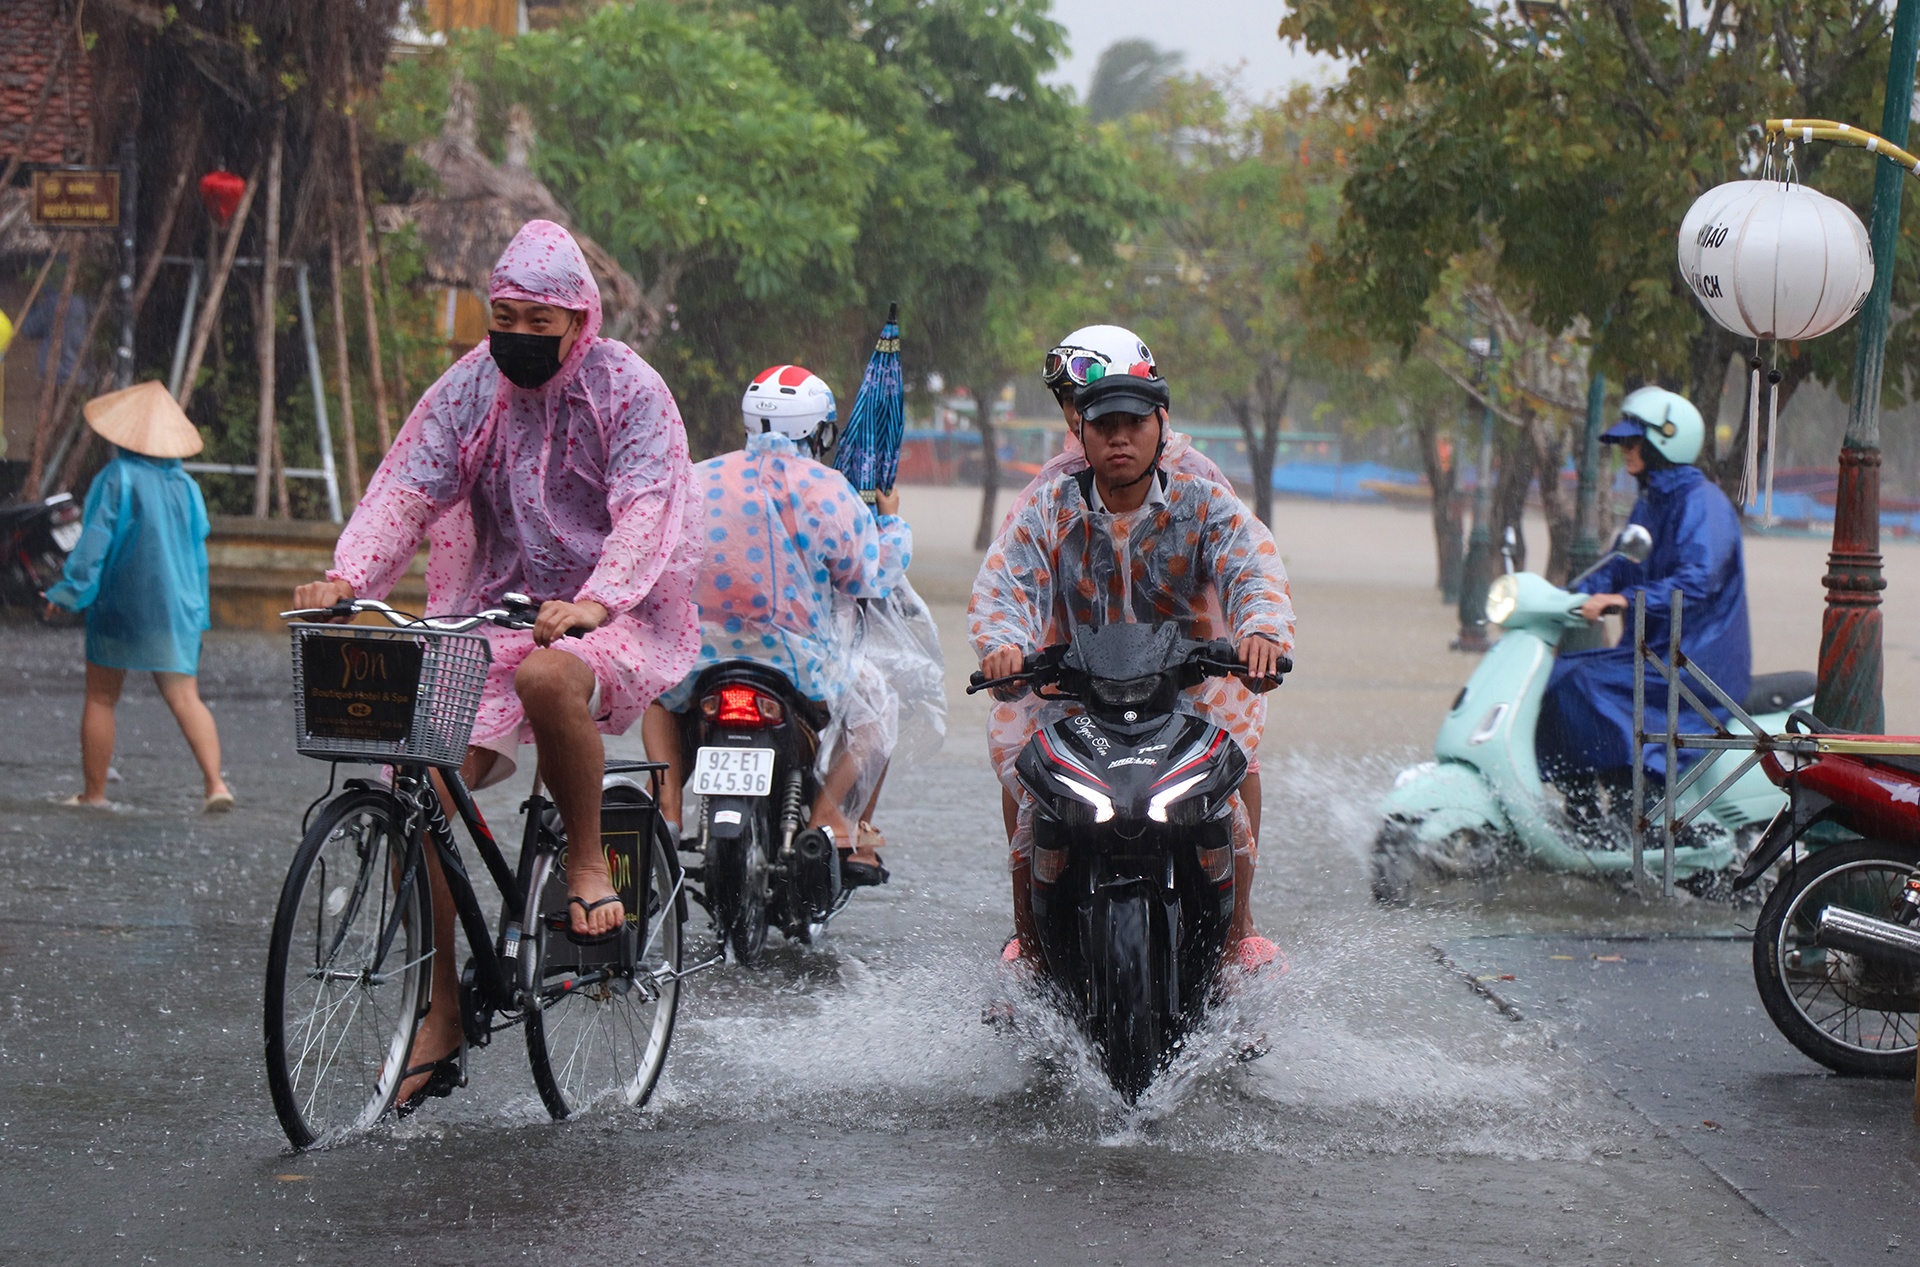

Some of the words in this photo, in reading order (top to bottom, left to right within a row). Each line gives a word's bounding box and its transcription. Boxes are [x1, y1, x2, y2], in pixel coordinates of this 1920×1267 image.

[355, 690, 380, 701] Hotel
[391, 692, 410, 704] Spa
[709, 752, 759, 771] 92-E1
[700, 772, 767, 792] 645.96
